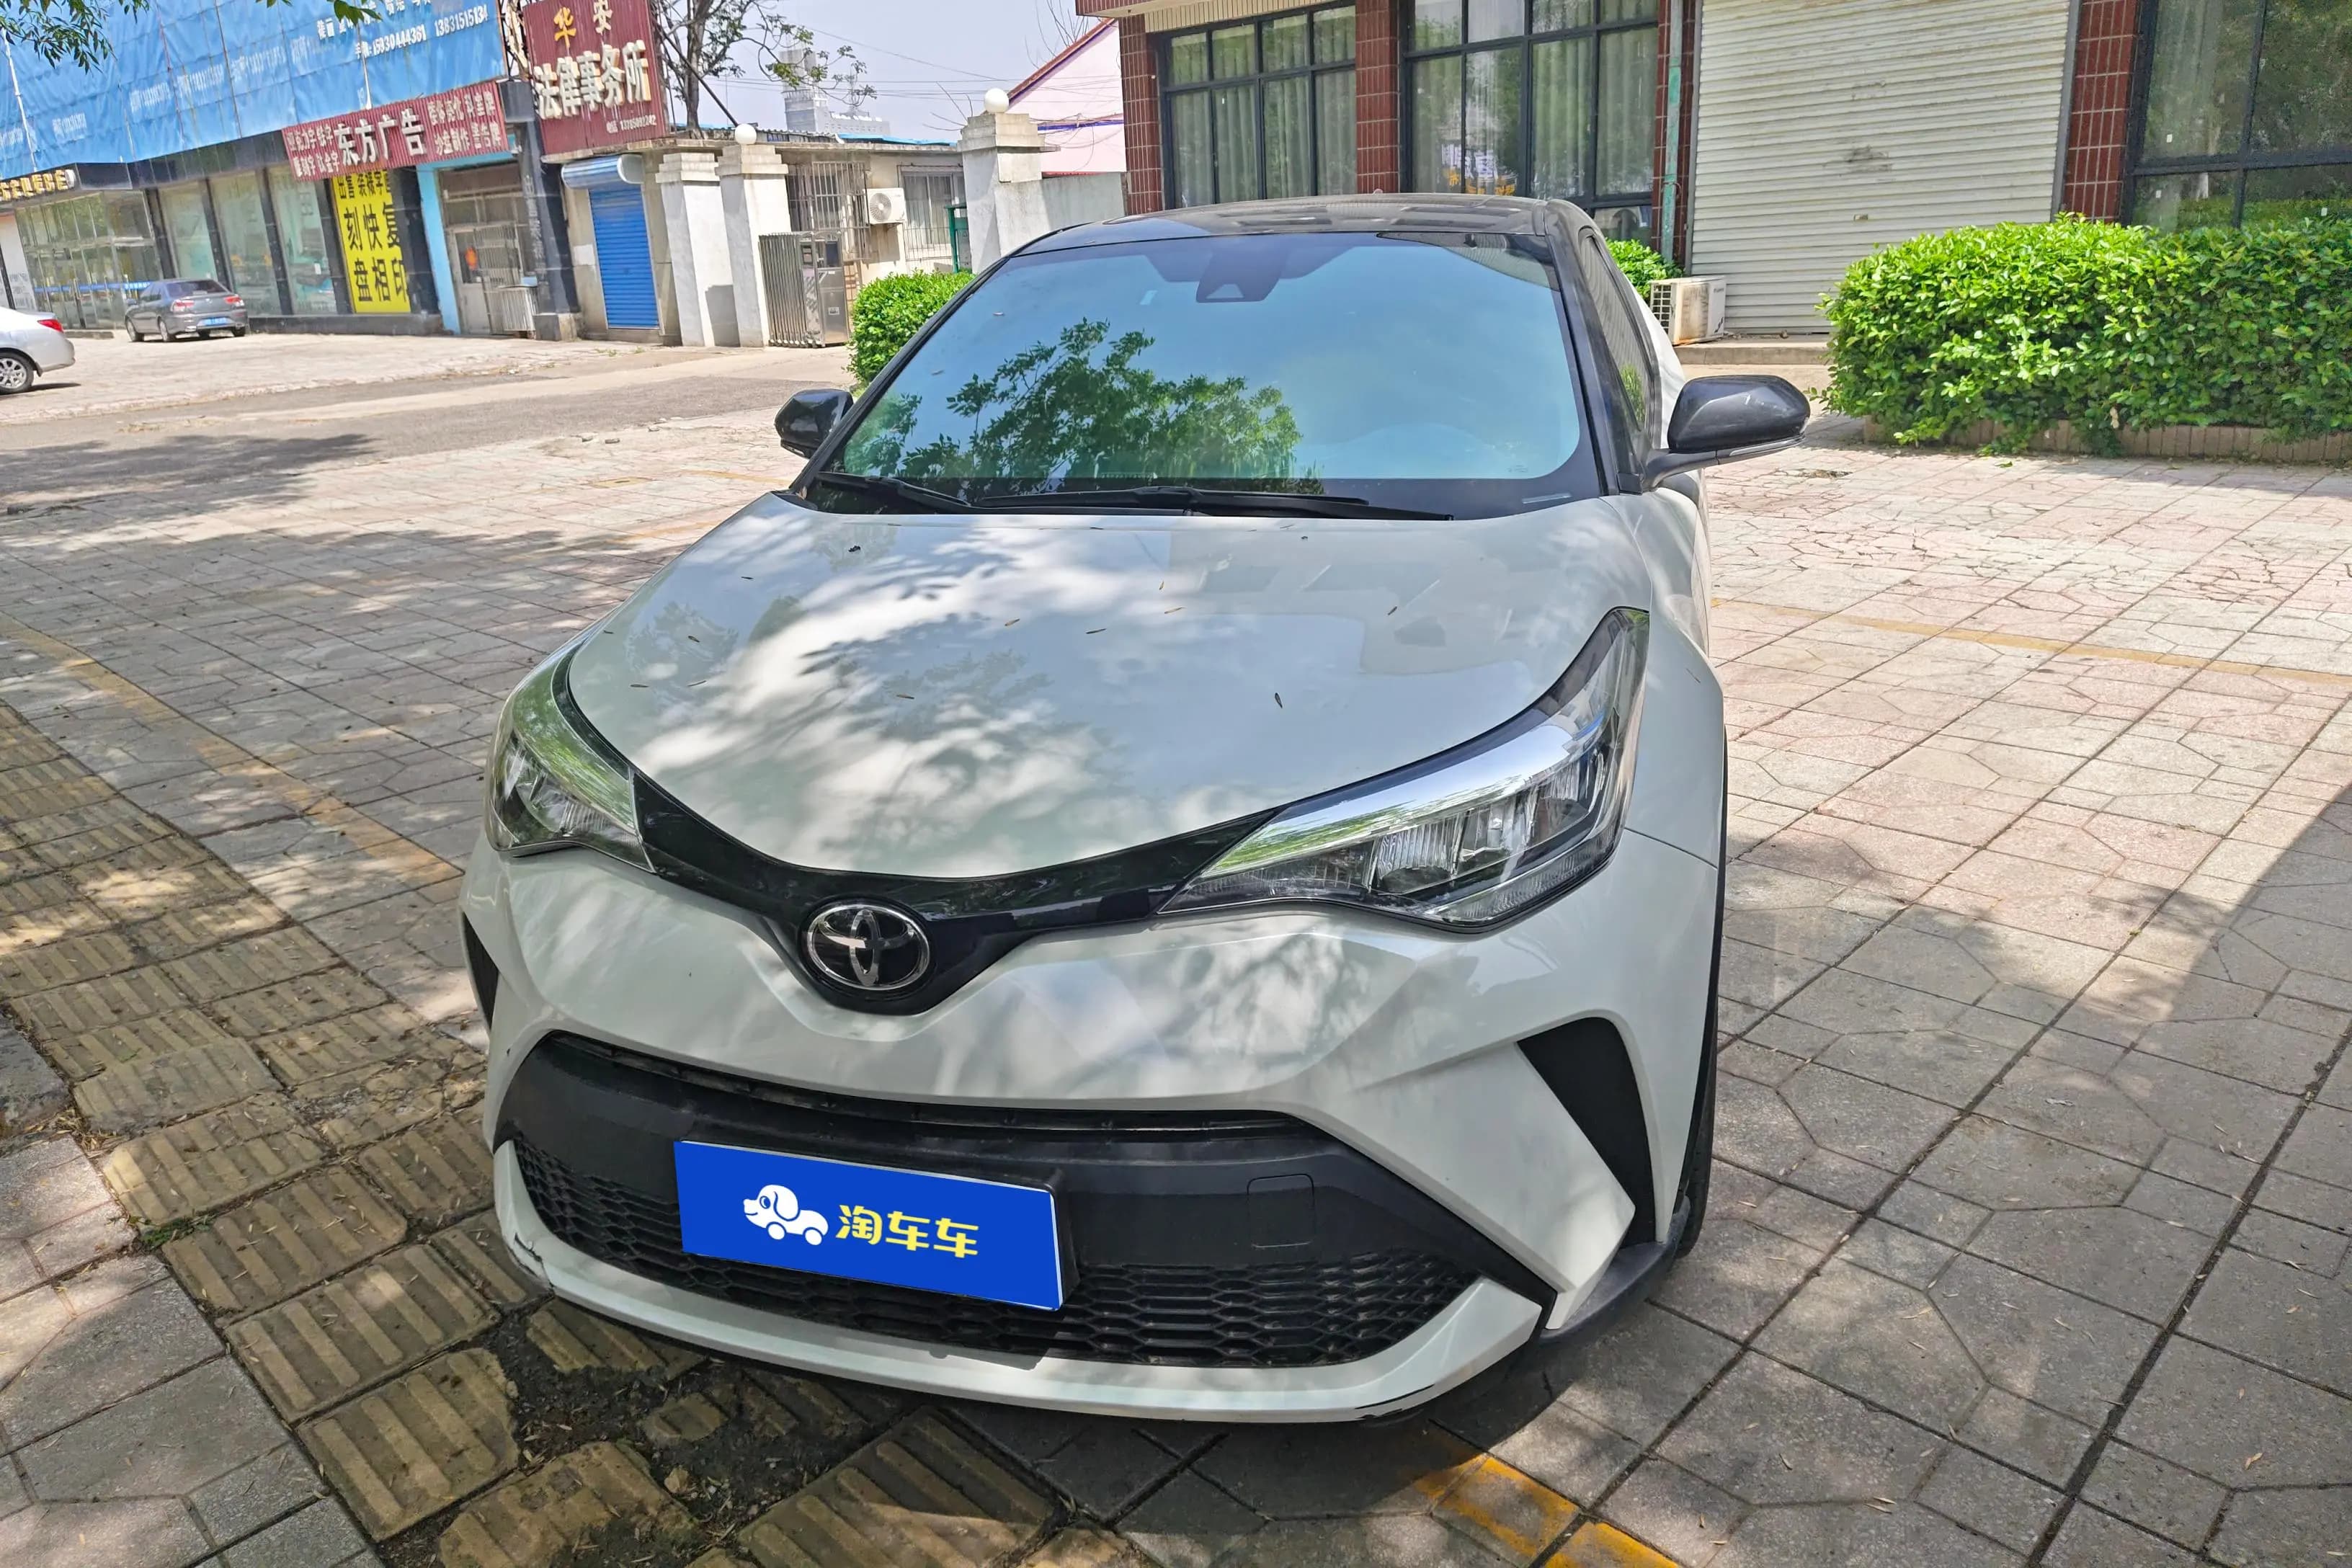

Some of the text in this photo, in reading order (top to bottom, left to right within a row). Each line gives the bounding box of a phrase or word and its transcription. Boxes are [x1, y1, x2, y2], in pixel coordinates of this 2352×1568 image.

[534, 40, 651, 120] 法律事务所
[334, 107, 427, 166] 东方广告
